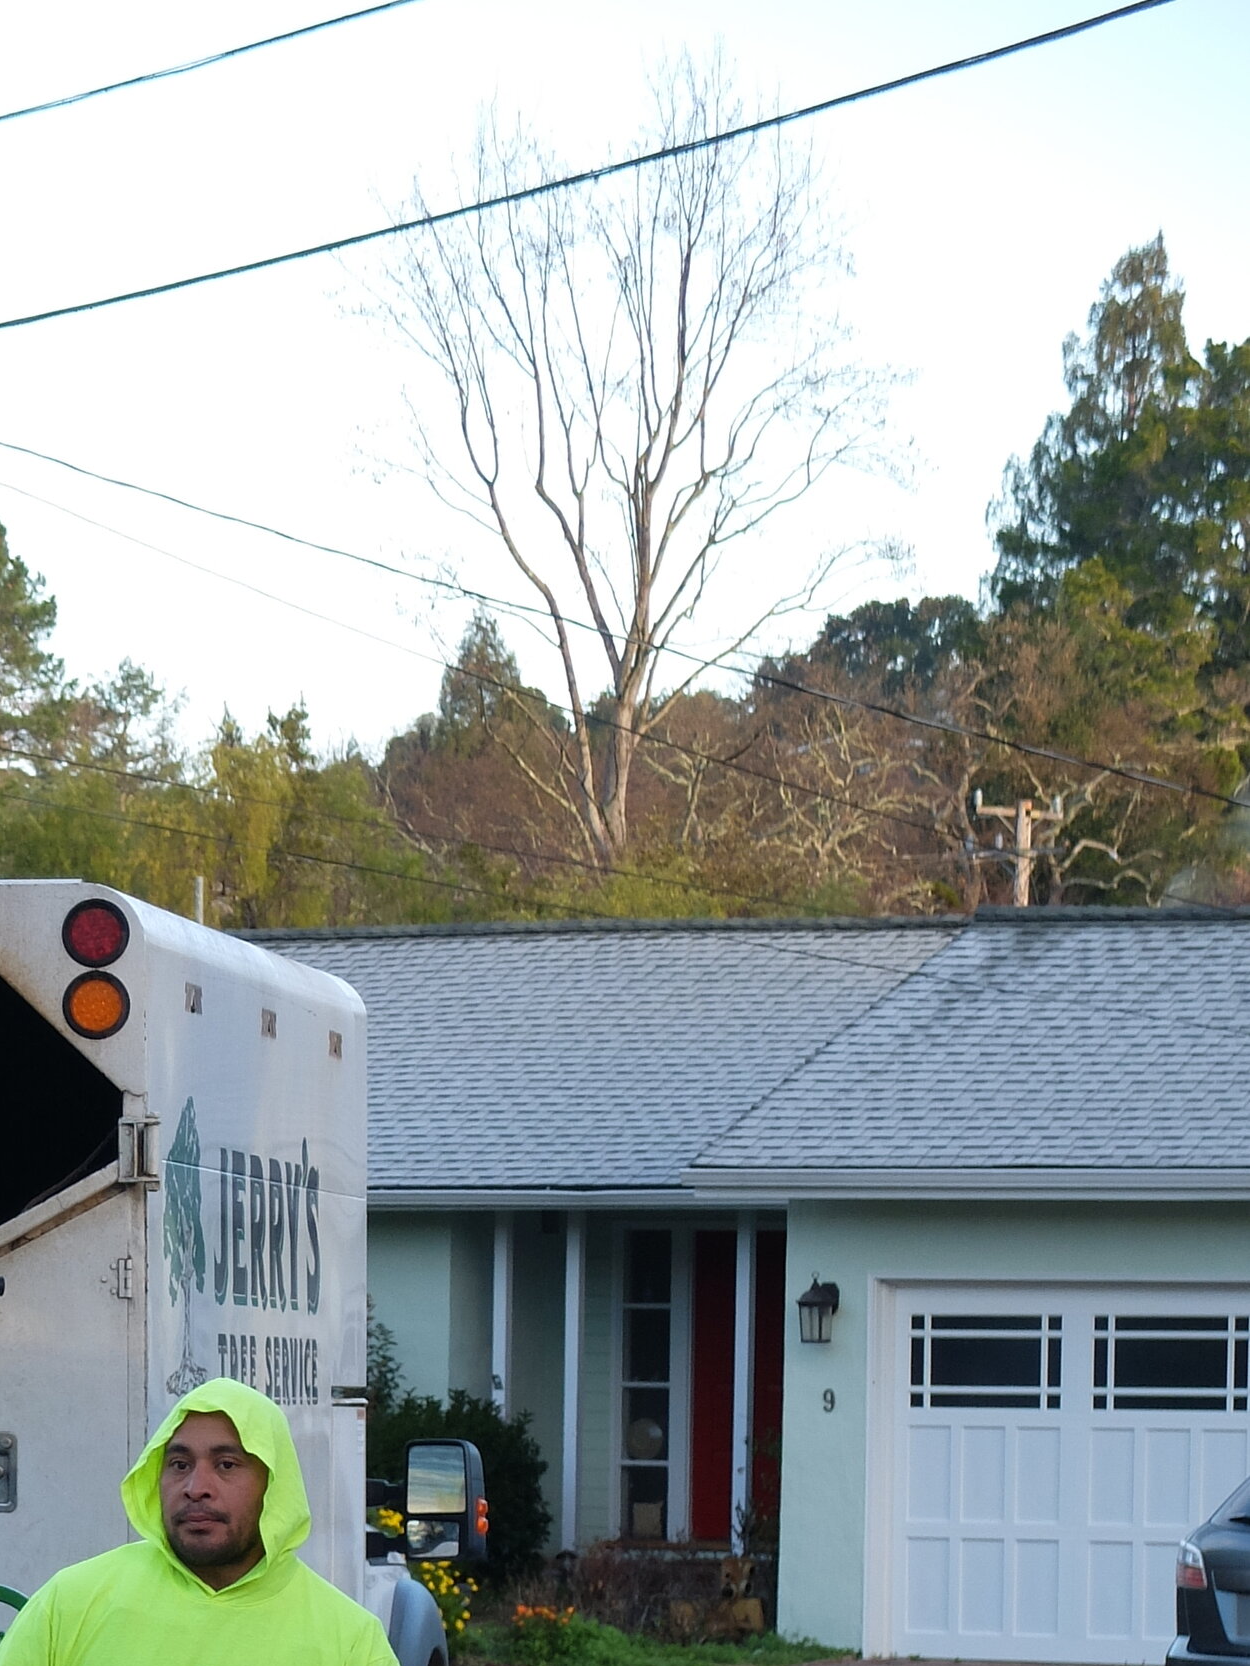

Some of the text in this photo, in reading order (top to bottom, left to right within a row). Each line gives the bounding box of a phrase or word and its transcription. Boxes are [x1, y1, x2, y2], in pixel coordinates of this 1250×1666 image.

[214, 1137, 321, 1316] JERRY'S
[218, 1333, 319, 1406] TREE SERVICE
[823, 1388, 836, 1413] 9
